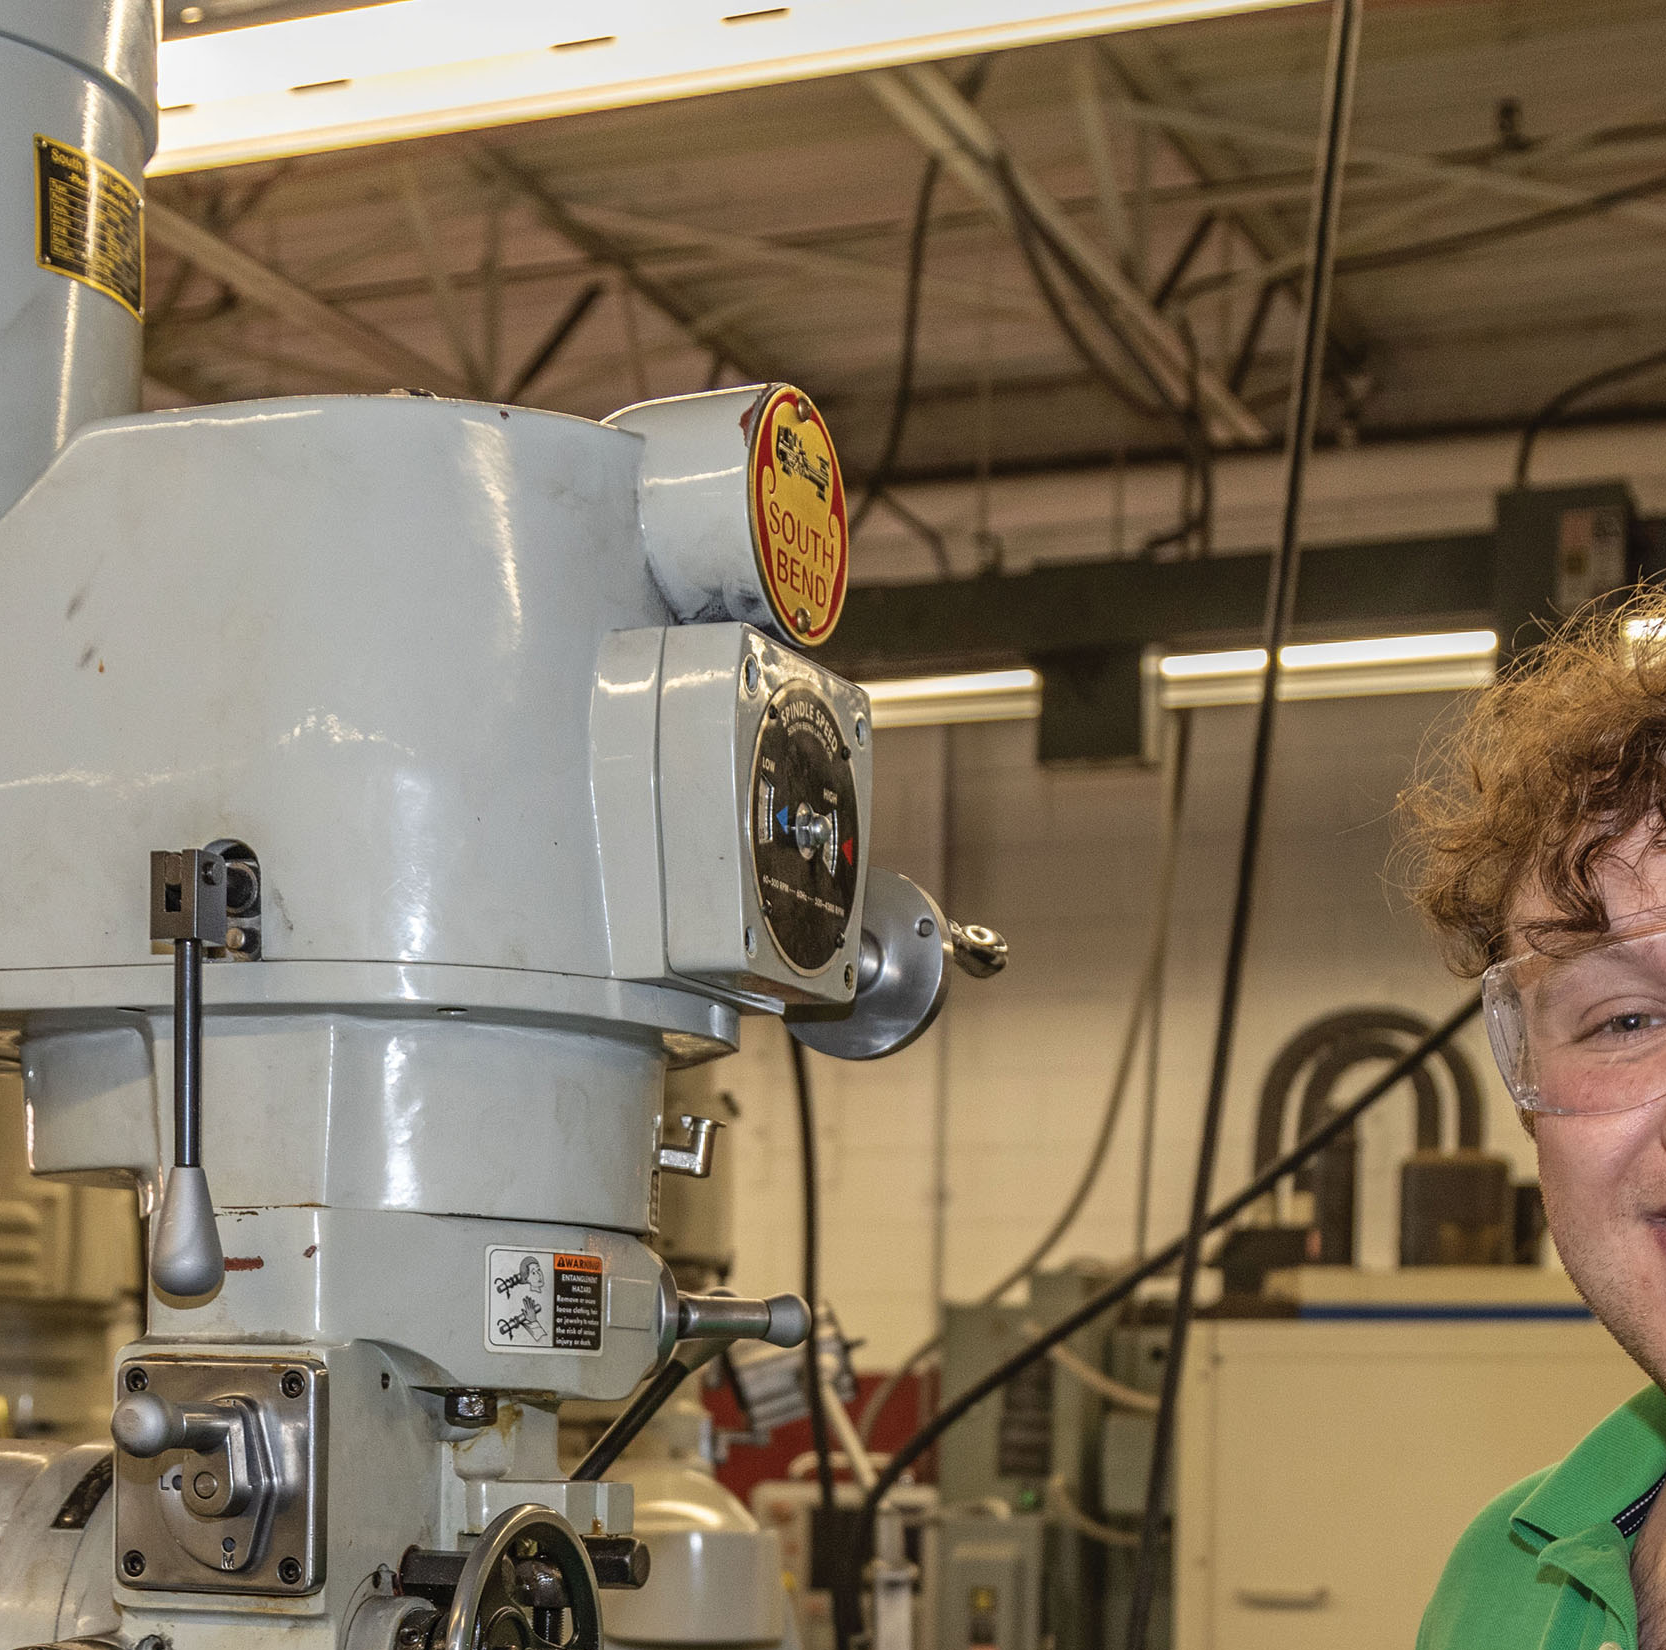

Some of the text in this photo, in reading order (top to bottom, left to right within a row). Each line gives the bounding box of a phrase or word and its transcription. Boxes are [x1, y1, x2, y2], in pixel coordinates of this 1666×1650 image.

[768, 500, 835, 573] SOUTH
[776, 547, 828, 608] BEND
[780, 700, 838, 753] SPINDLE SPEED
[762, 755, 776, 775] LOW
[823, 787, 838, 805] HIGH
[565, 1257, 600, 1271] WARNING
[571, 1285, 592, 1294] HAZARD
[556, 1304, 572, 1314] loose
[556, 1327, 566, 1335] the
[160, 1475, 170, 1491] L
[221, 1553, 235, 1570] M
